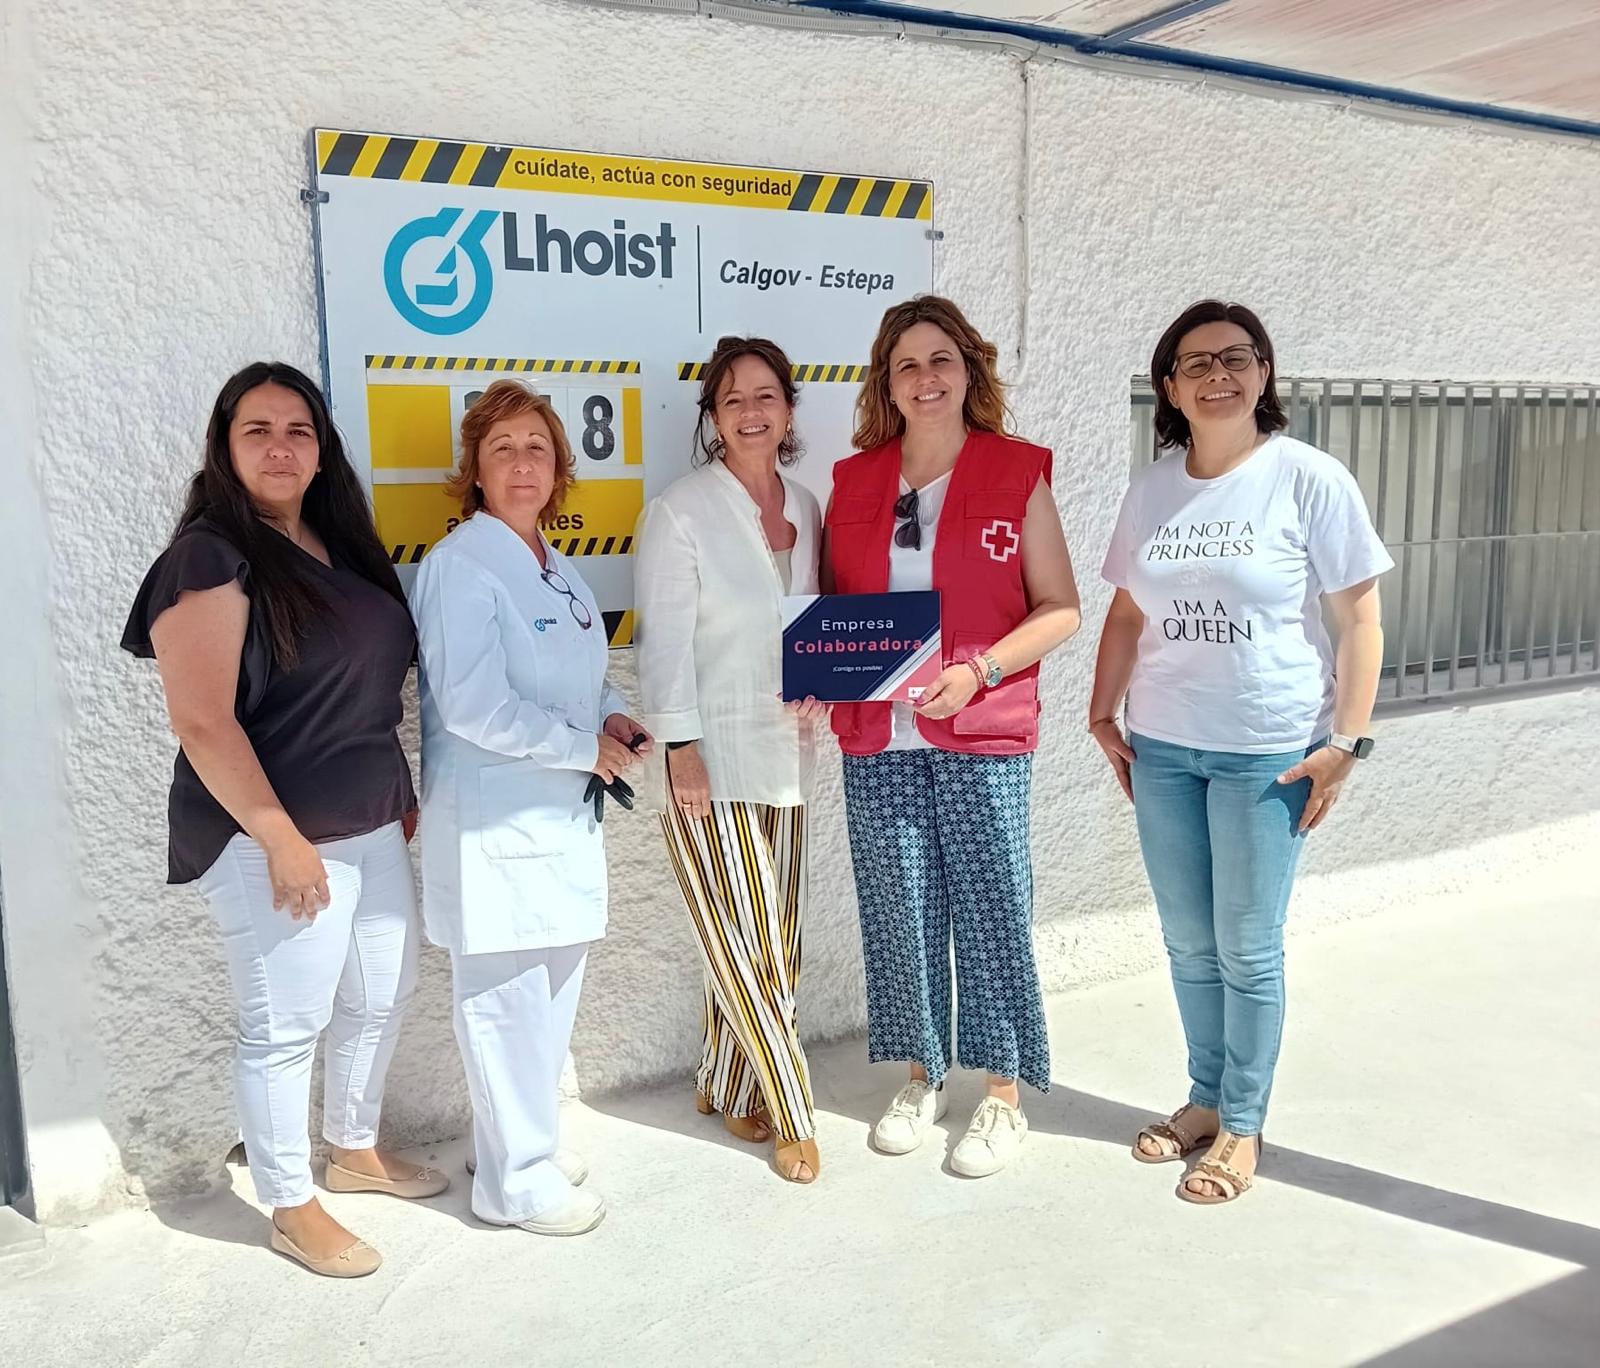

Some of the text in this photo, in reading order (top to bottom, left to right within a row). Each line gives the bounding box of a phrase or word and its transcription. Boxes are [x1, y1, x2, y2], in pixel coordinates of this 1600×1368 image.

[514, 157, 792, 197] cuídate, actúa con seguridad
[502, 211, 677, 279] Lhoist
[719, 259, 801, 291] Calgov
[819, 265, 895, 295] Estepa
[1188, 521, 1236, 539] NOT
[1240, 521, 1254, 536] A
[1147, 539, 1254, 561] PRINCESS
[1173, 598, 1227, 616] I'M A
[821, 619, 894, 633] Empresa
[1163, 617, 1252, 644] QUEEN
[794, 637, 922, 654] Colaboradora
